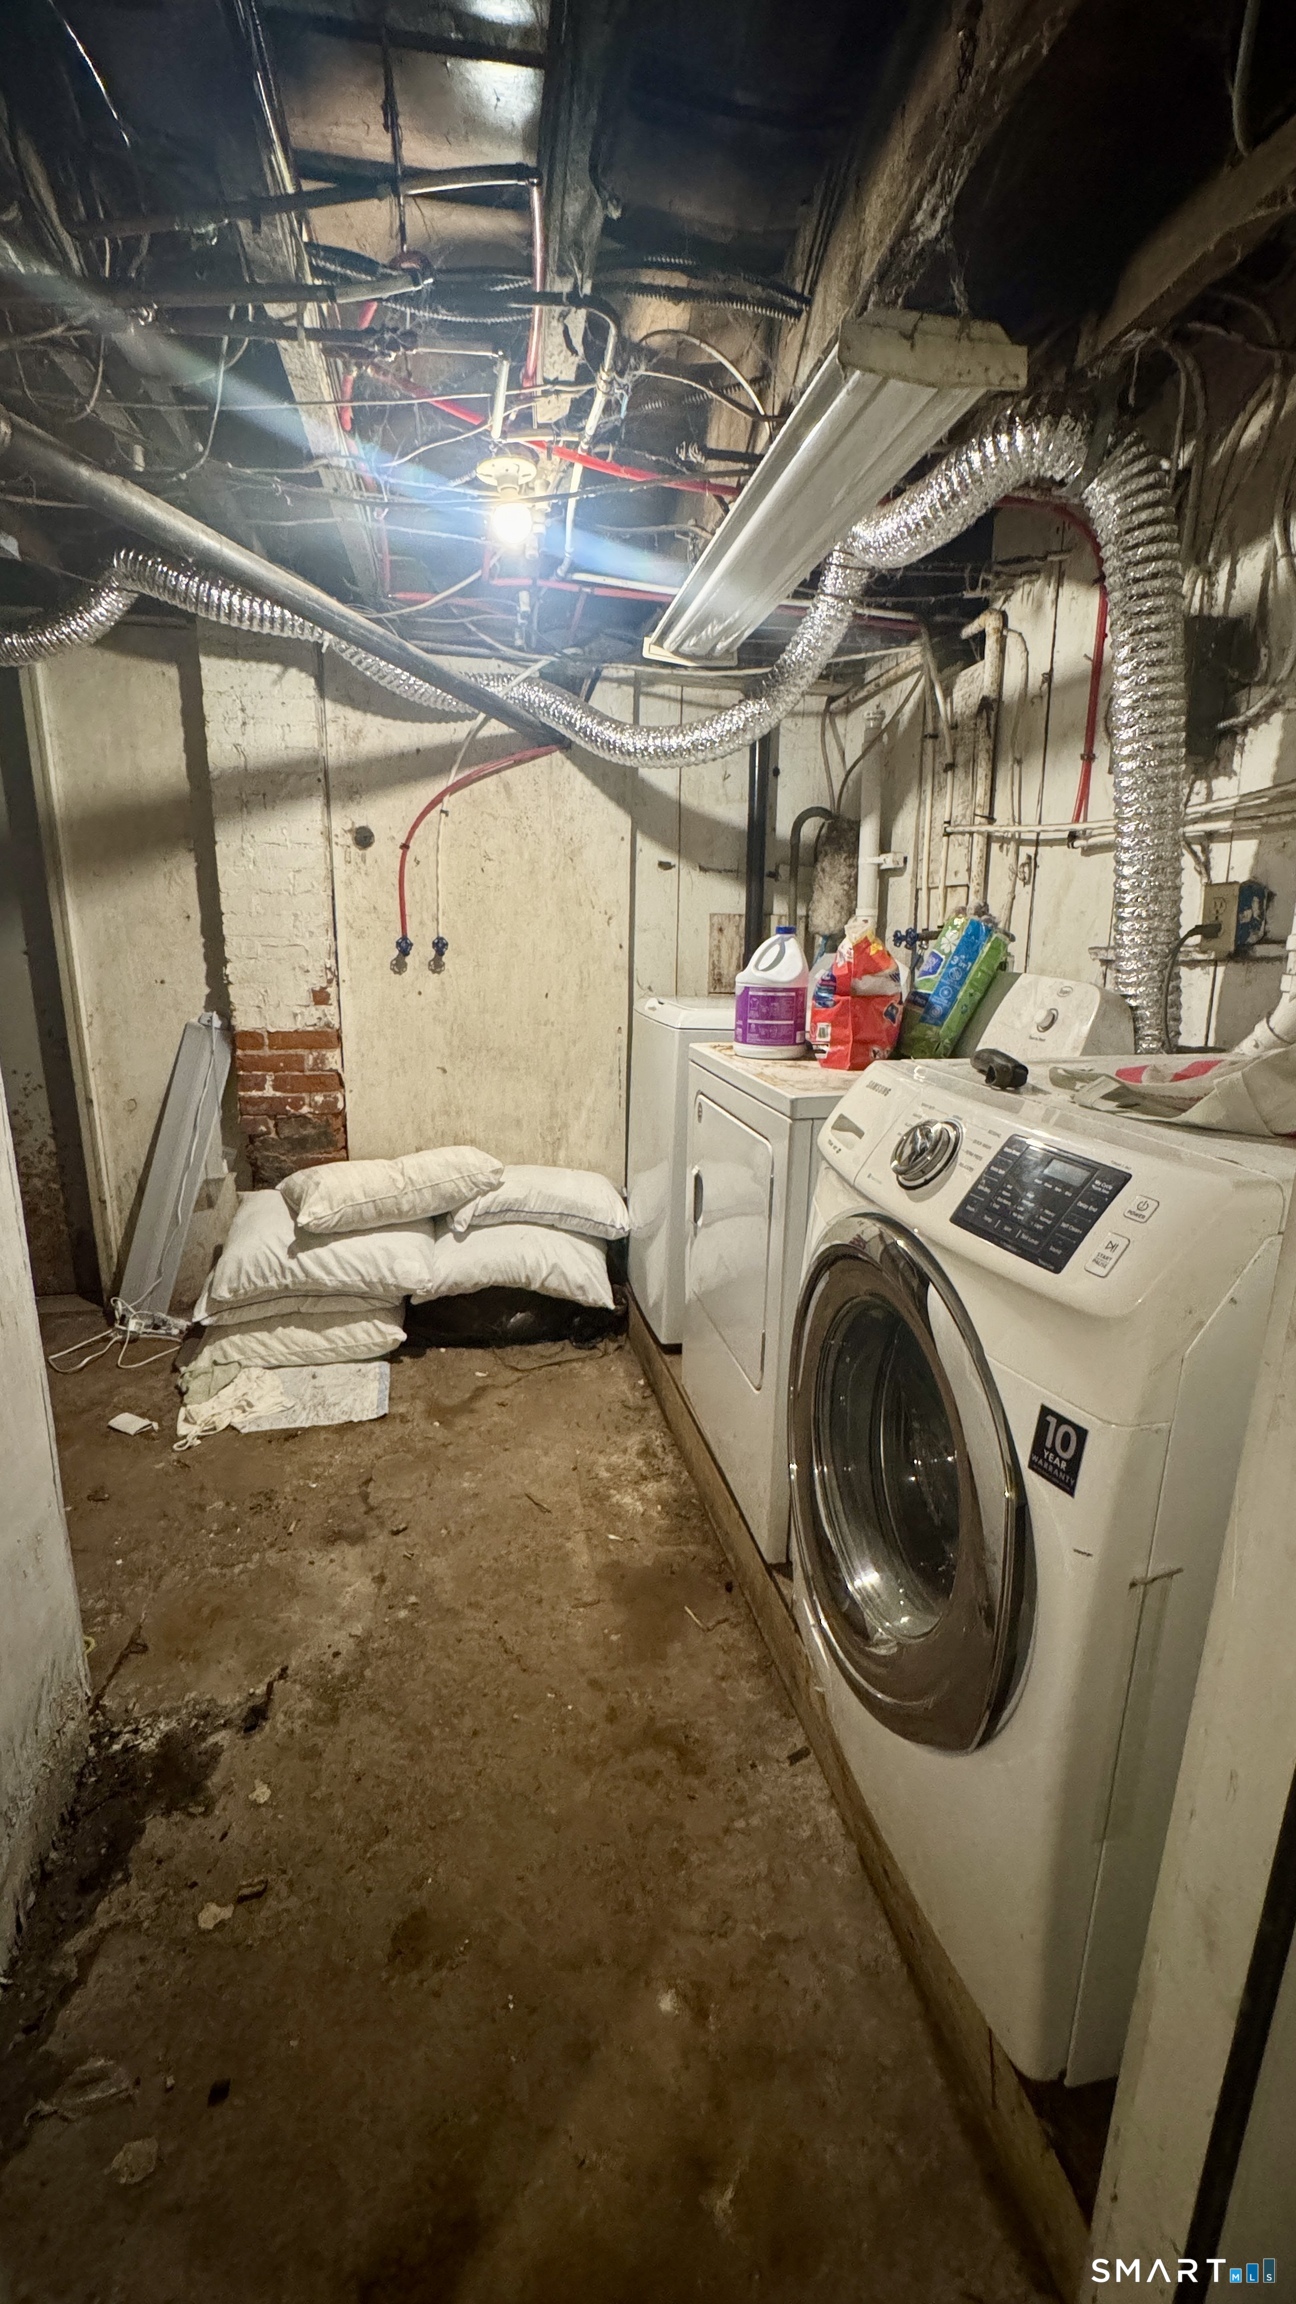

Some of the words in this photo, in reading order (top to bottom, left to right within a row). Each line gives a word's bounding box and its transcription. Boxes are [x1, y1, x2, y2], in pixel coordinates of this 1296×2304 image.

[866, 1080, 892, 1096] SAMSUNG
[1127, 1209, 1146, 1219] POWER
[1092, 1258, 1108, 1269] PAUSE
[1096, 1252, 1113, 1262] START
[1045, 1414, 1077, 1460] 10
[1043, 1449, 1067, 1471] YEAR
[1031, 1453, 1075, 1486] WARRANTY
